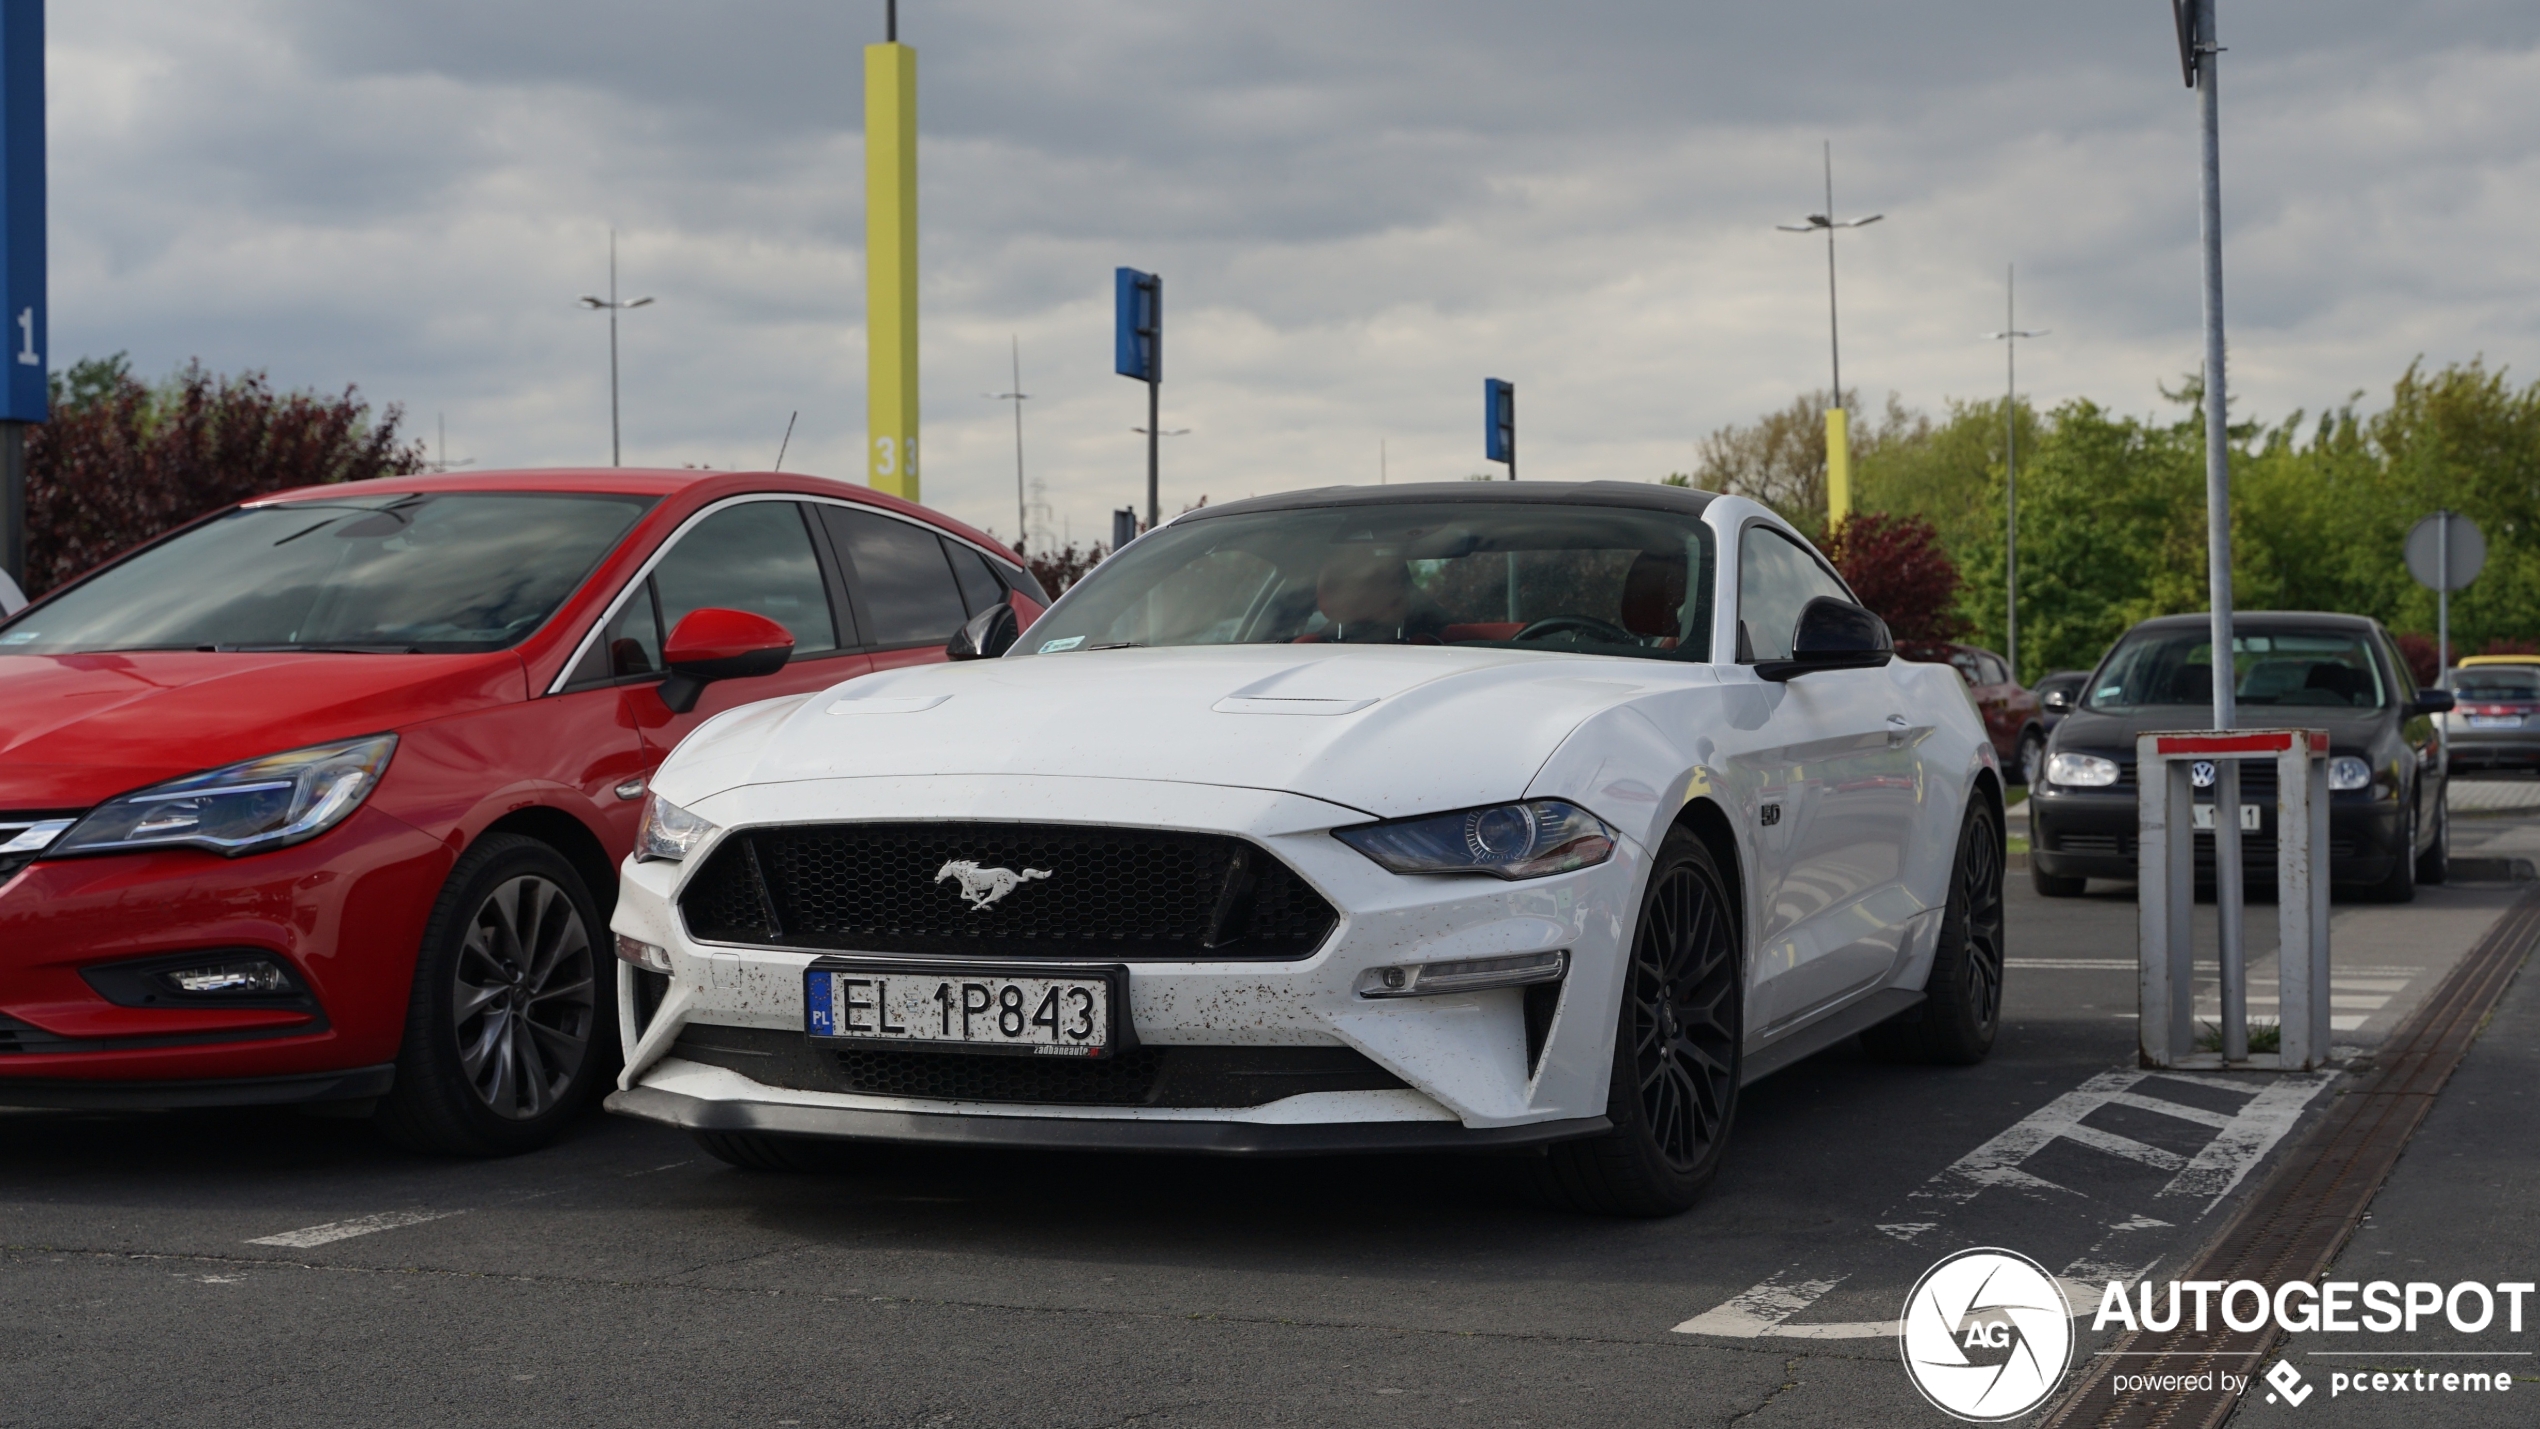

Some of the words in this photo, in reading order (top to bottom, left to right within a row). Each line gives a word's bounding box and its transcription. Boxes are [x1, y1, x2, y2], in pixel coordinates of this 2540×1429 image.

[17, 305, 39, 366] 1
[876, 435, 896, 476] 3
[905, 437, 917, 476] 3
[812, 1010, 830, 1026] PL
[843, 978, 905, 1034] EL
[933, 982, 1094, 1041] 1P843
